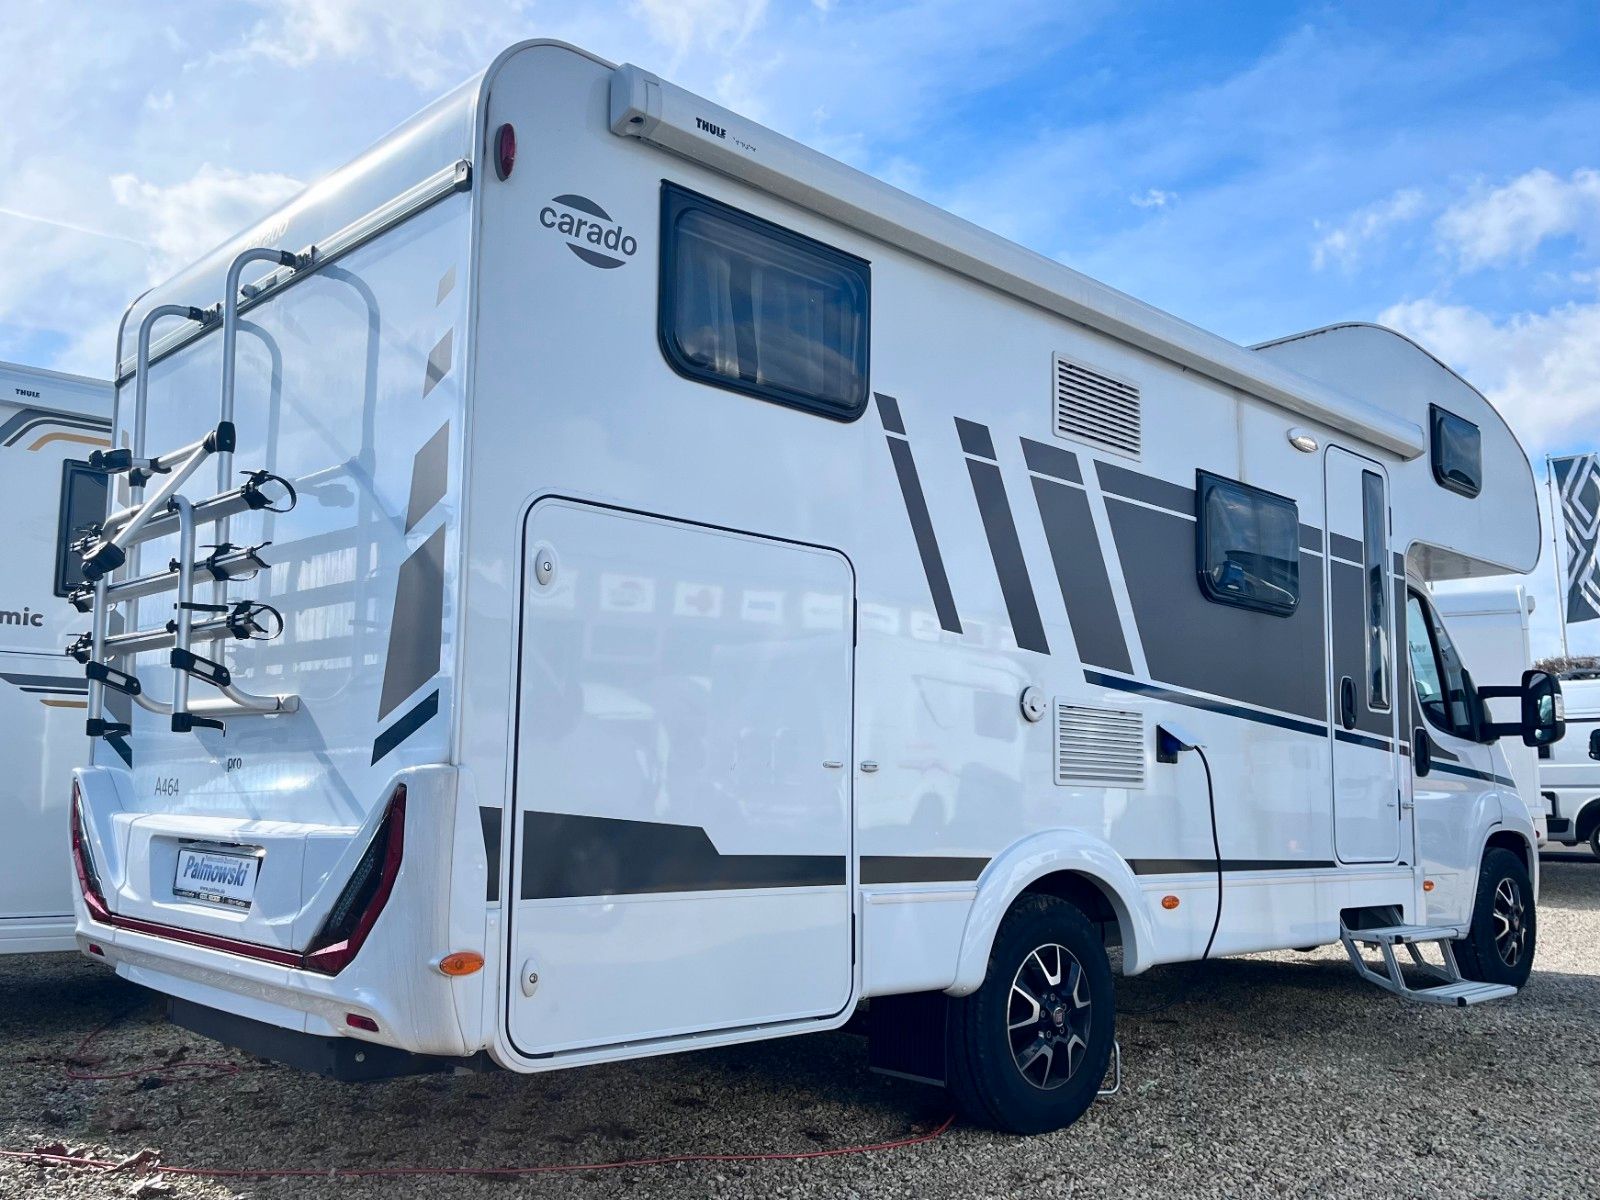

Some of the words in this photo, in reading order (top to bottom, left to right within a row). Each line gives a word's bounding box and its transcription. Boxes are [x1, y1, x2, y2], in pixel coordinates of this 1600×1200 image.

[696, 117, 726, 139] THULE
[540, 207, 637, 255] carado
[15, 388, 40, 398] THULE
[227, 758, 242, 772] pro
[155, 777, 179, 796] A464
[183, 856, 250, 886] Palmowski
